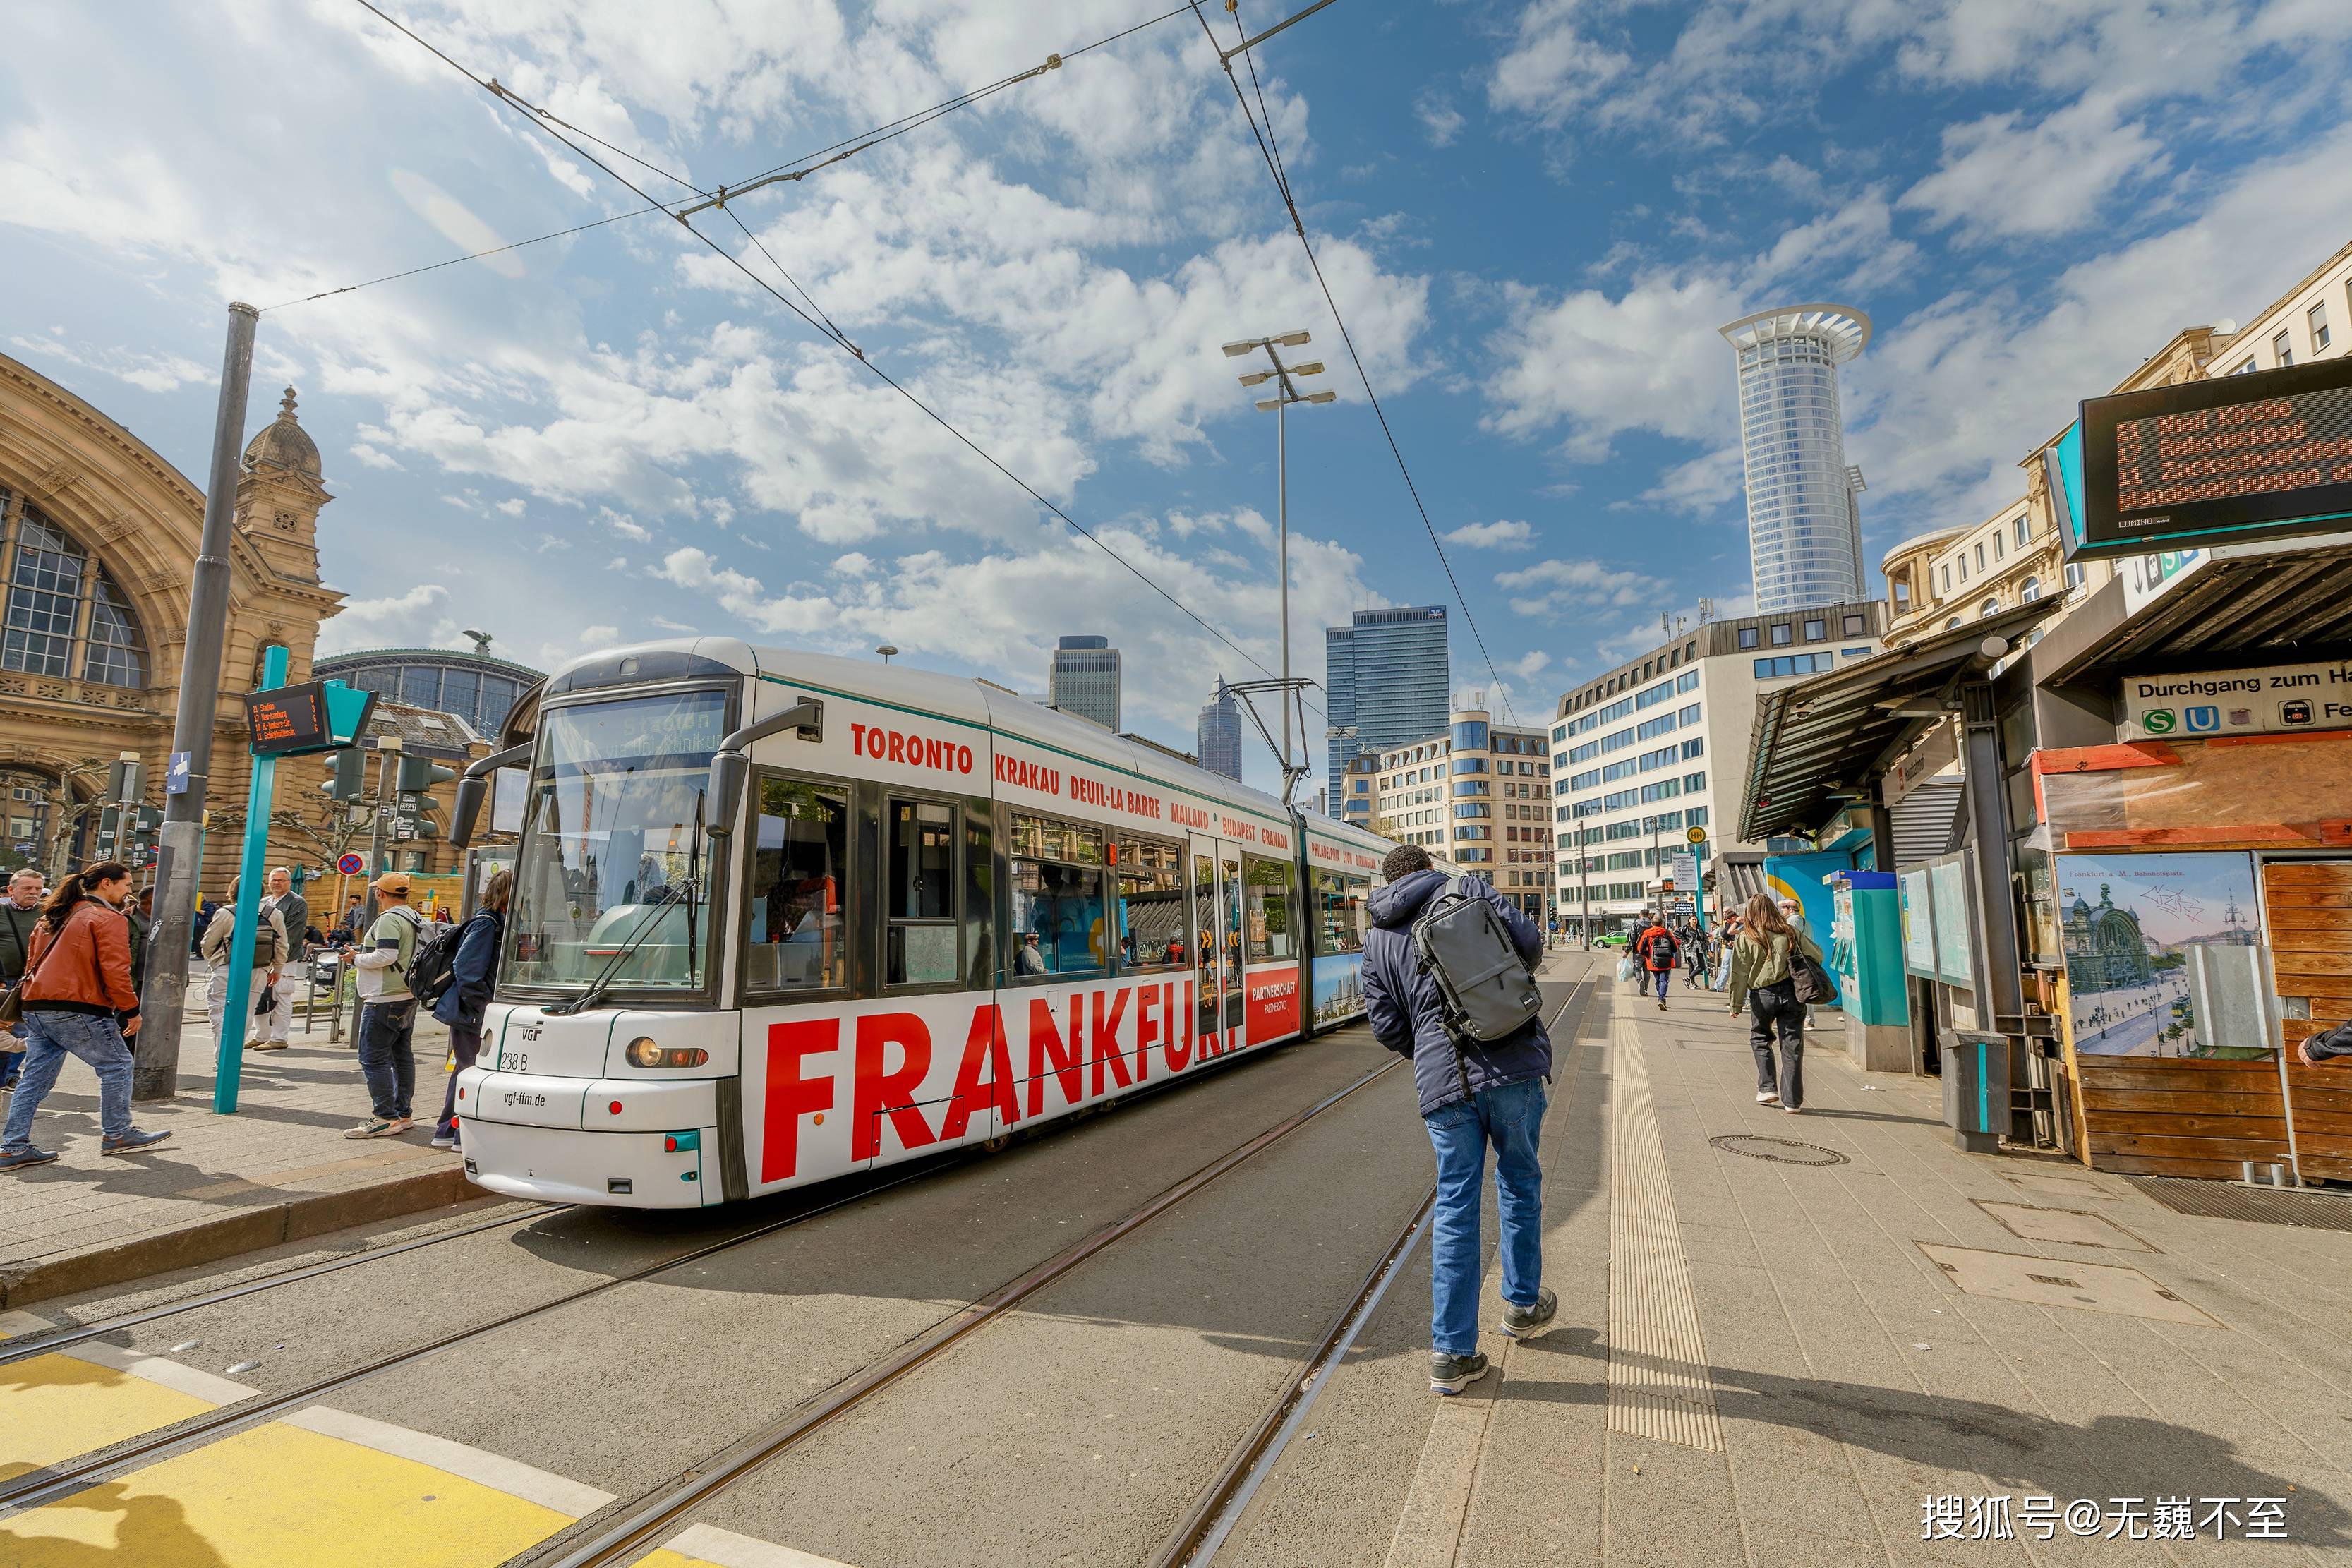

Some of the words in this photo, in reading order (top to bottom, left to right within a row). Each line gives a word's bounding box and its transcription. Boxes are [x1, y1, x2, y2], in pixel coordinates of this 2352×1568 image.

[2117, 420, 2142, 442] 21
[2159, 411, 2207, 435] Nied
[2218, 401, 2292, 426] Kirche
[2118, 443, 2142, 464] 17
[2159, 418, 2305, 458] Rebstockbad
[2118, 466, 2143, 486] 11
[2119, 469, 2320, 512] planabweichungen
[2118, 518, 2153, 528] LUMINO
[2138, 677, 2261, 698] Durchgang
[2270, 674, 2320, 688] zum
[850, 723, 973, 775] TORONTO
[994, 752, 1060, 796] KRAKAU
[1071, 776, 1123, 812] DEUIL-LA
[1128, 790, 1161, 820] BARRE
[1171, 802, 1209, 830] MAILAND
[1222, 816, 1255, 842] BUDAPEST
[1262, 828, 1289, 850] GRANADA
[1311, 842, 1340, 862] PHILADELPHIA
[1252, 981, 1296, 1002] PARTNERSCHAFT
[1264, 1000, 1287, 1014] PARTNERSTVO
[522, 1028, 543, 1042] VGF
[501, 1052, 519, 1071] 238
[520, 1054, 528, 1071] B
[504, 1092, 545, 1106] vgf-ffm.de
